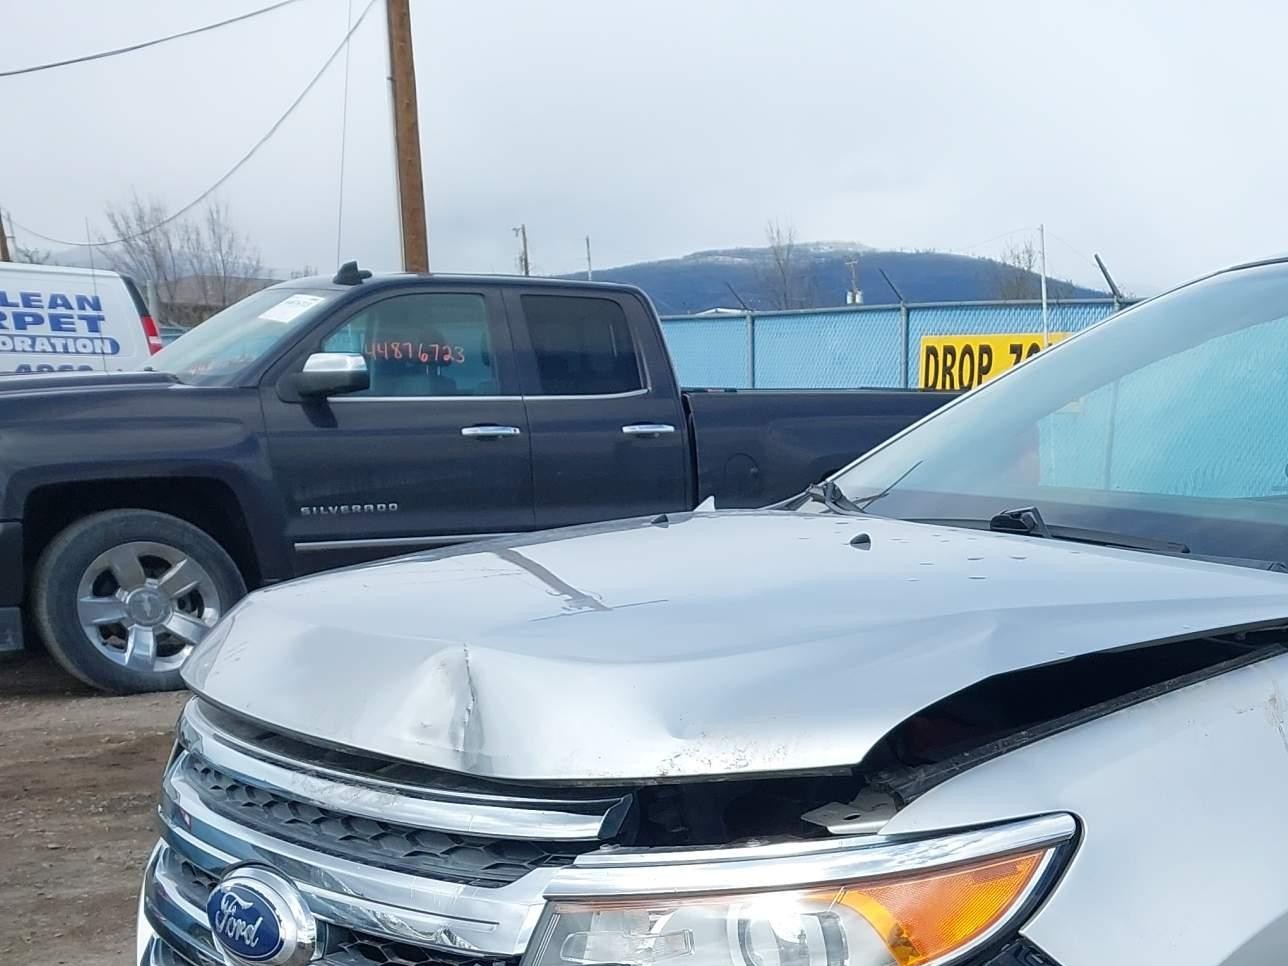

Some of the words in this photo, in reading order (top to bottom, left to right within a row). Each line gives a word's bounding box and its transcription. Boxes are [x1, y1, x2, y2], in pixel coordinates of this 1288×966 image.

[0, 311, 105, 333] PET
[365, 342, 465, 363] 44876723
[924, 343, 993, 391] DROP
[299, 503, 399, 516] SILVERADO
[215, 891, 263, 948] Ford
